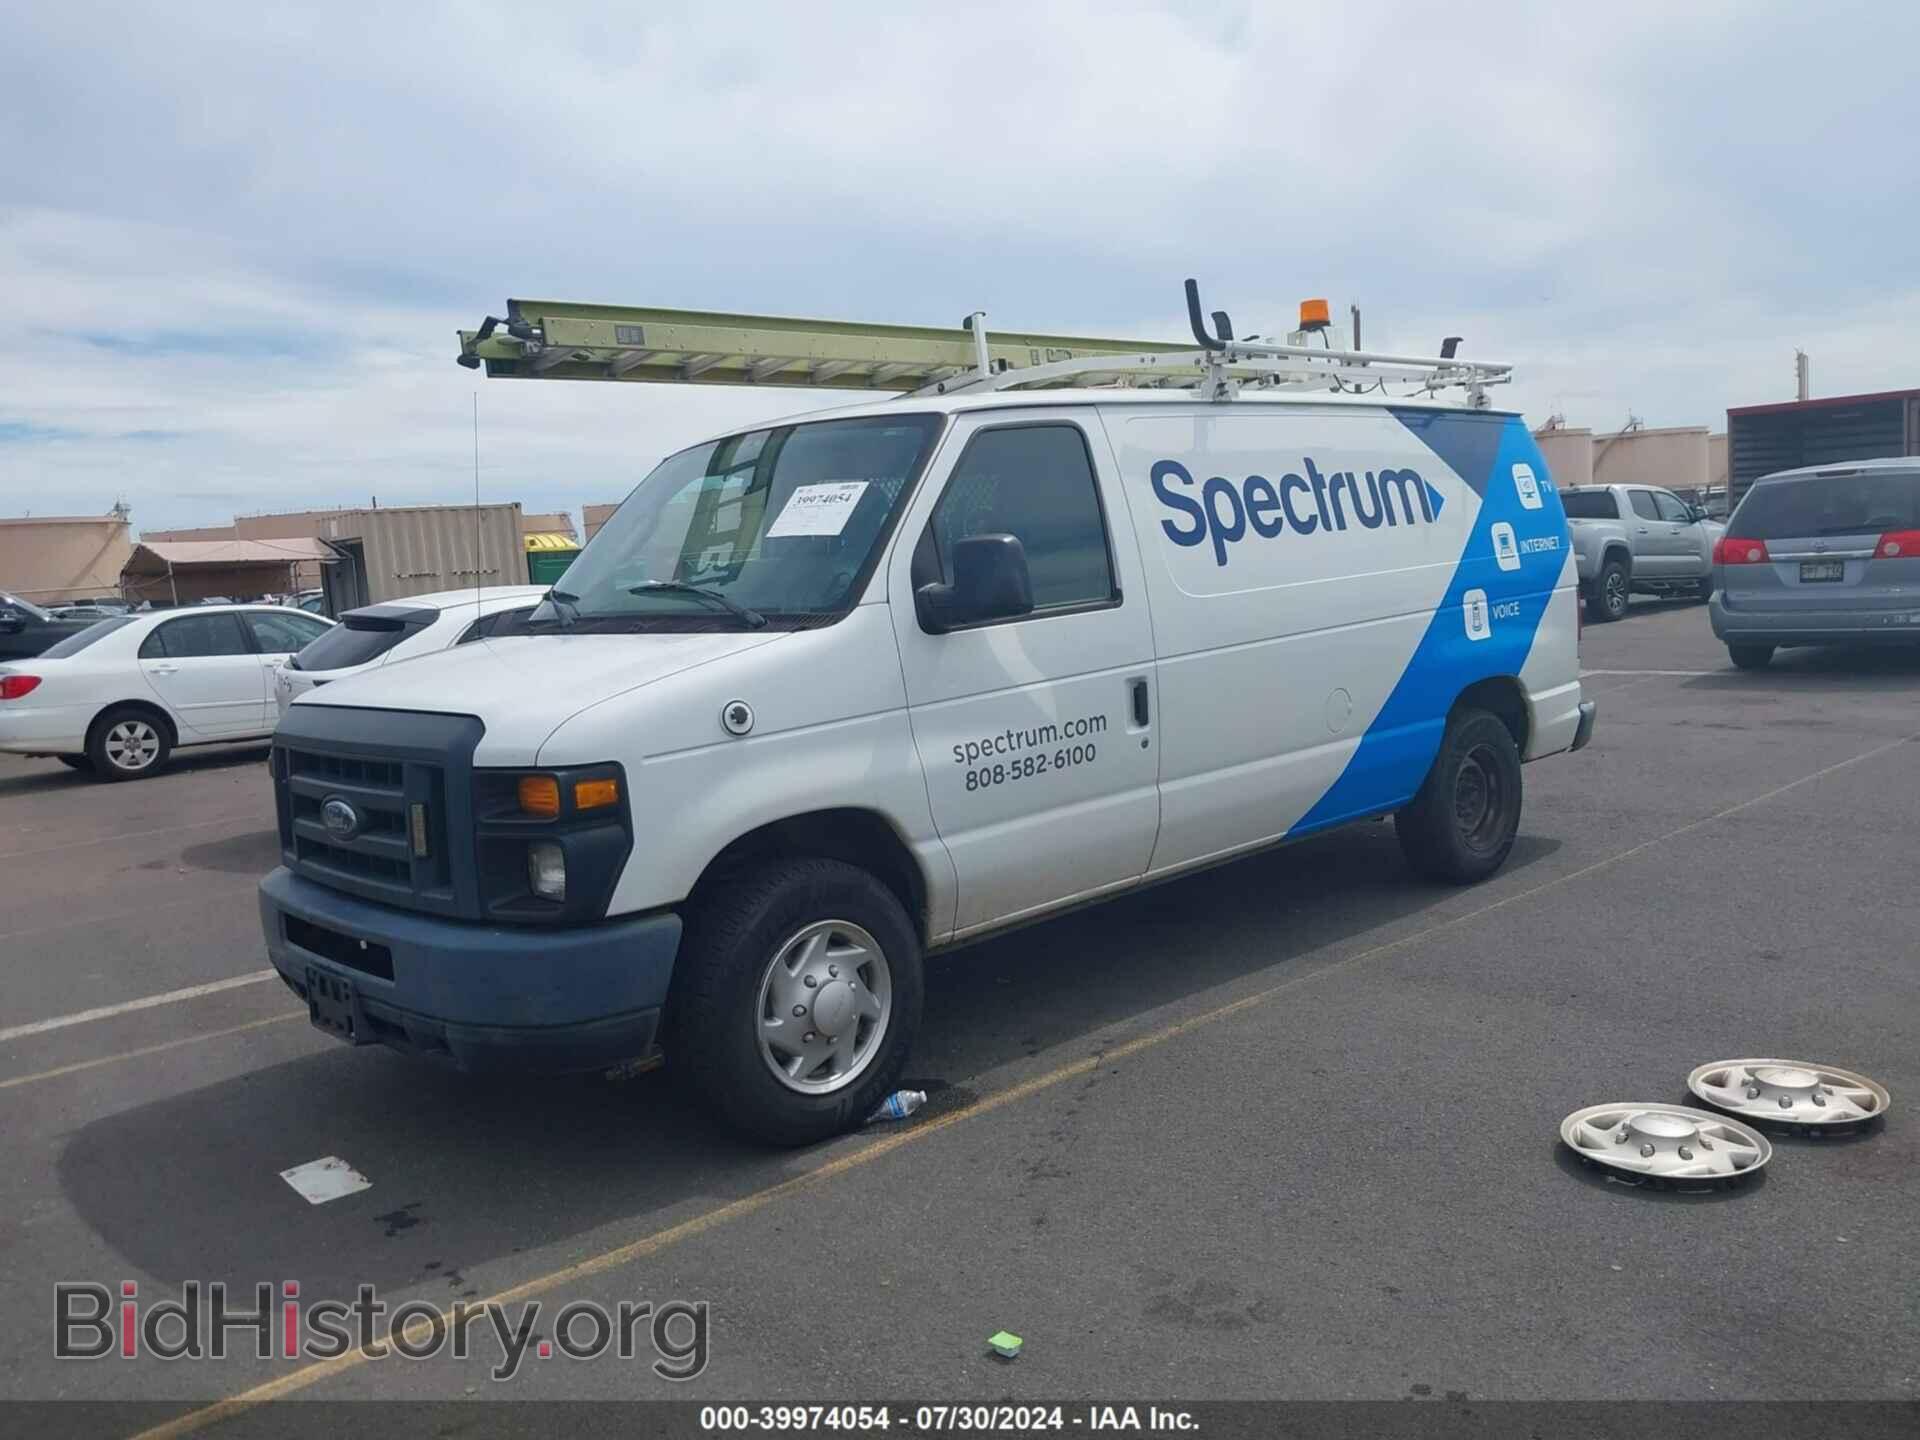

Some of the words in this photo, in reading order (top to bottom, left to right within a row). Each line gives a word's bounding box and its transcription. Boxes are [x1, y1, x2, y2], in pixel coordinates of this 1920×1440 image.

[1150, 457, 1433, 567] Spectrum
[1519, 536, 1560, 556] INTERNET
[1491, 602, 1521, 620] VOICE
[952, 714, 1107, 766] spectrum.com
[965, 743, 1096, 792] 808-582-6100
